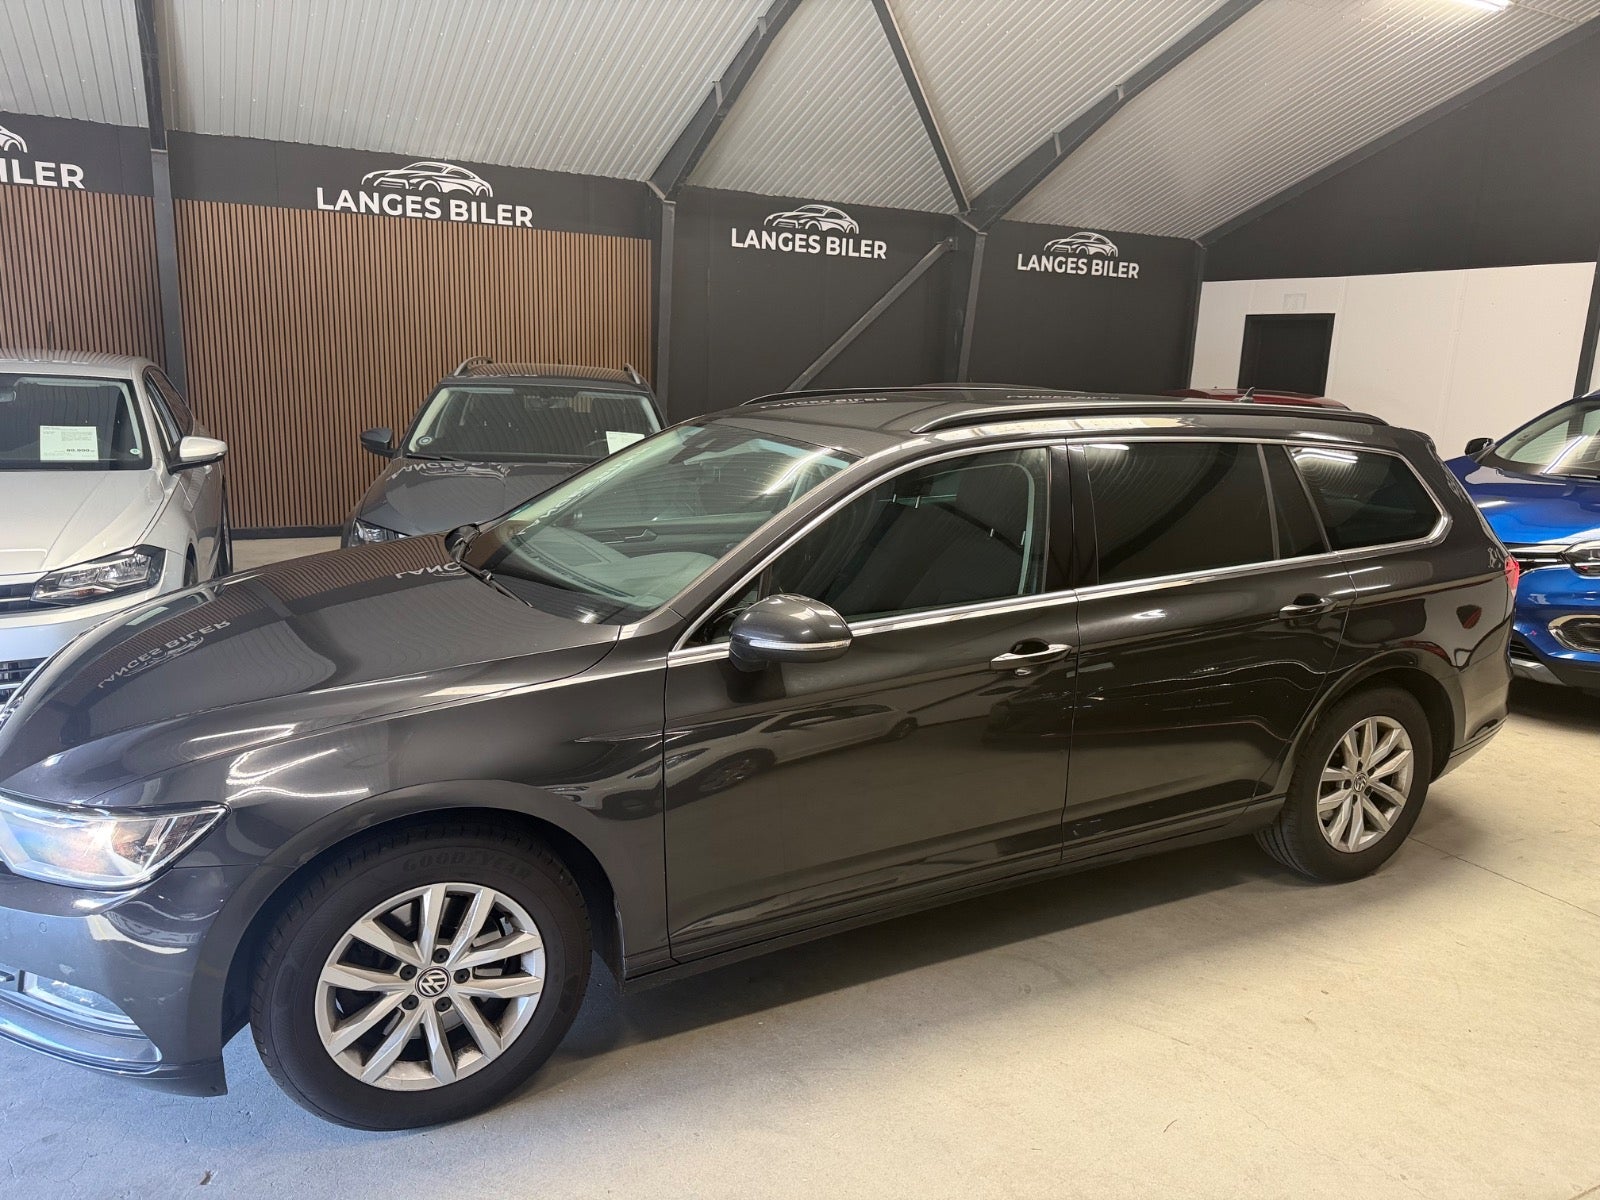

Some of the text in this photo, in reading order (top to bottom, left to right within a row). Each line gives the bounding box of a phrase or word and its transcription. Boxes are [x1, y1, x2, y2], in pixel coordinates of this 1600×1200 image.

[316, 187, 534, 228] LANGES BILER
[731, 227, 888, 260] LANGES BILER
[1016, 253, 1140, 279] LANGES BILER
